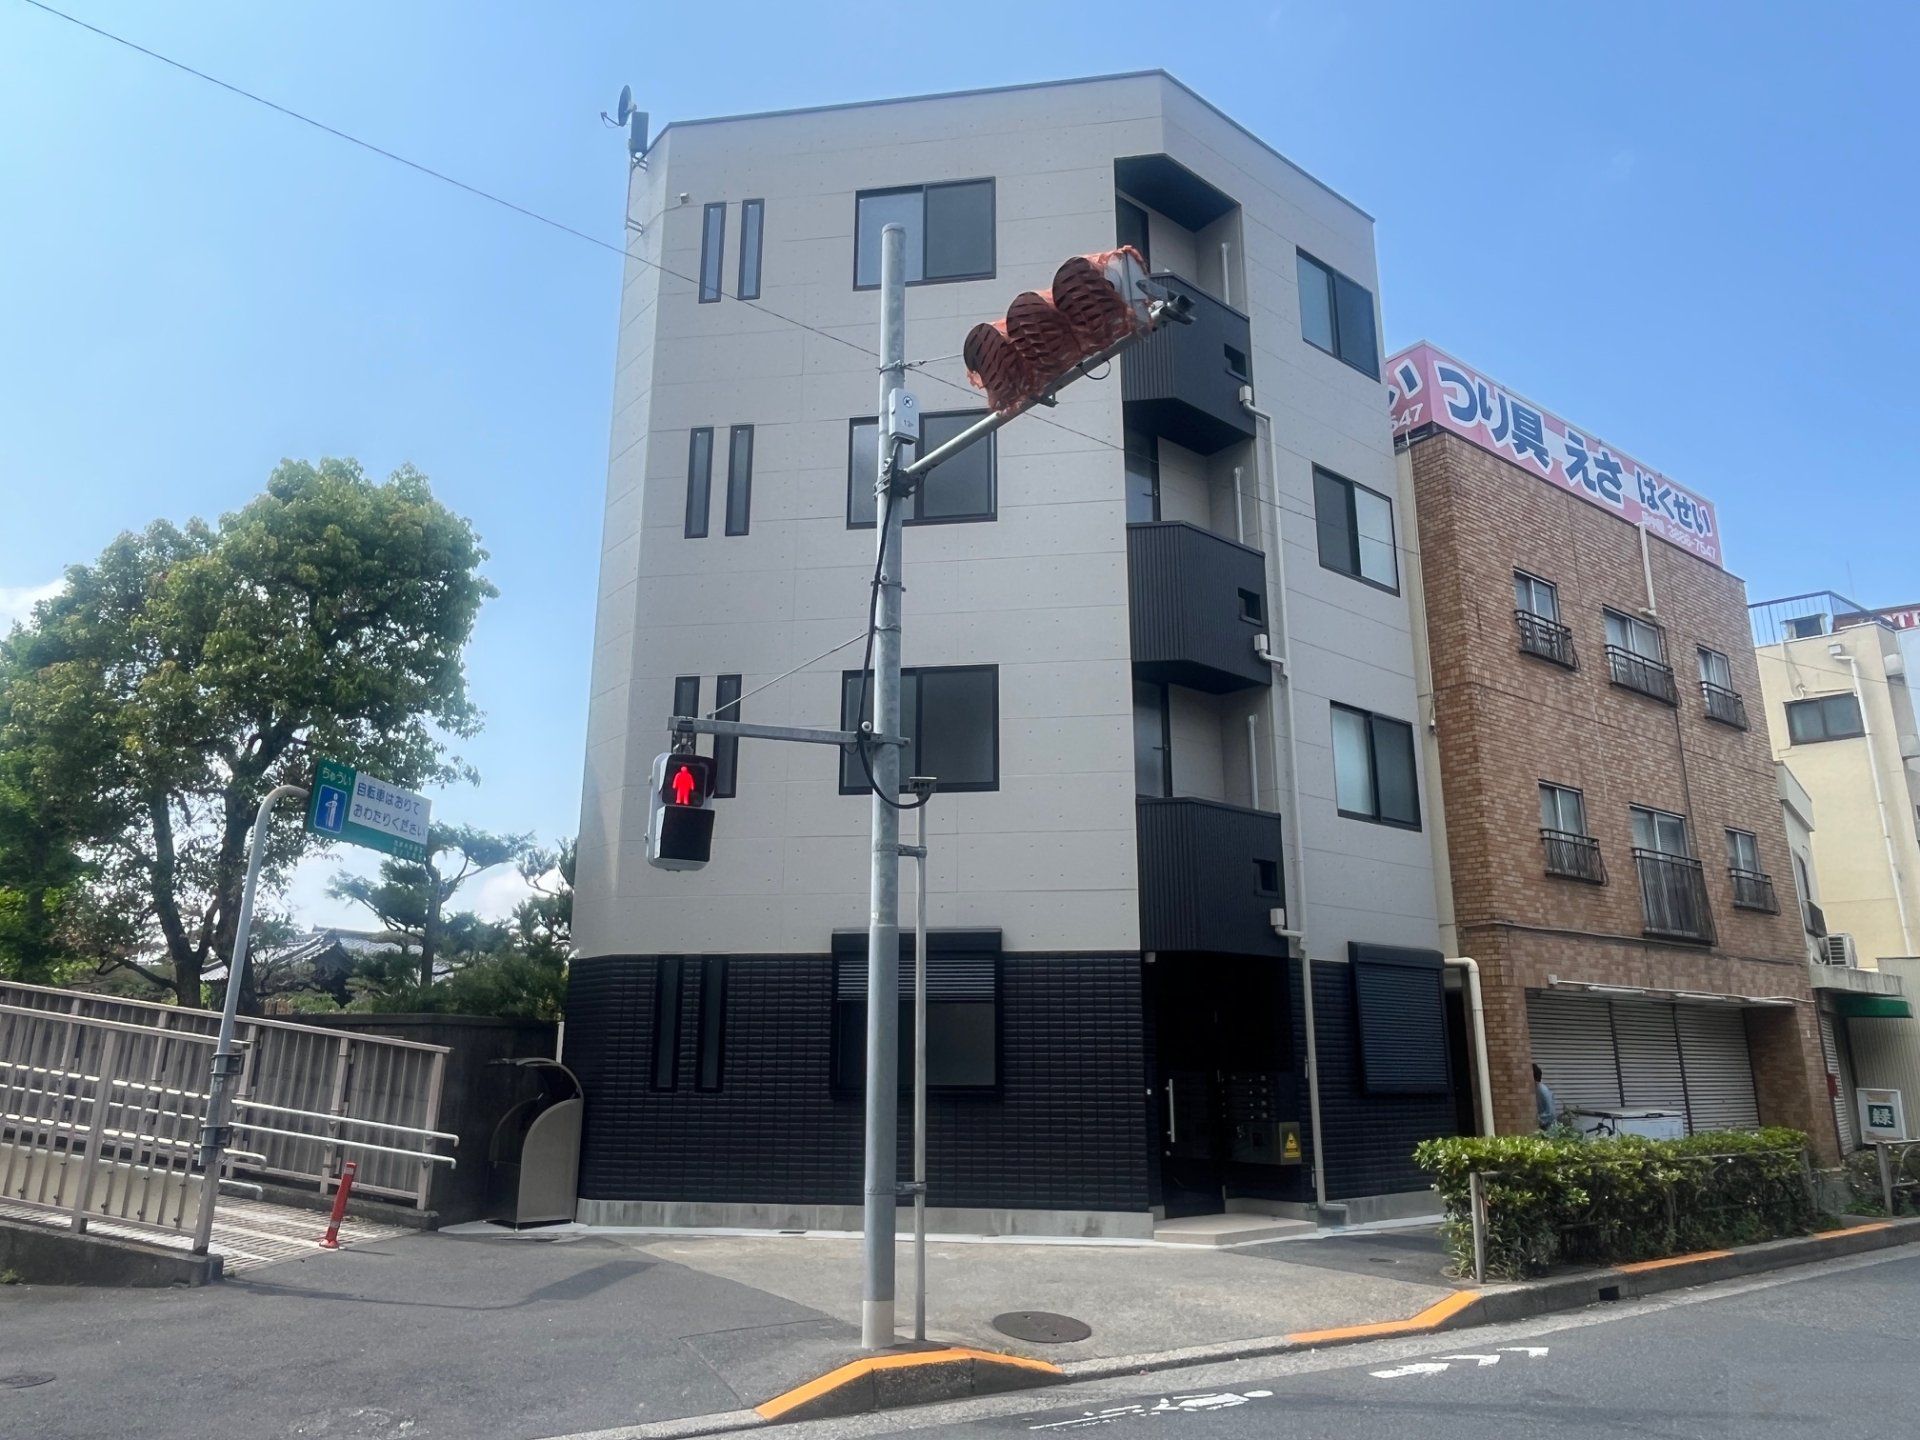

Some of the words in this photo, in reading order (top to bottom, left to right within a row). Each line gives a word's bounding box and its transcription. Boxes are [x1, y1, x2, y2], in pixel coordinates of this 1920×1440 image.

[1435, 361, 1551, 473] つり具
[1563, 427, 1624, 507] えさ
[1635, 468, 1713, 537] はくせい
[357, 782, 420, 815] 自転車はおりて
[353, 803, 426, 837] おわたりください
